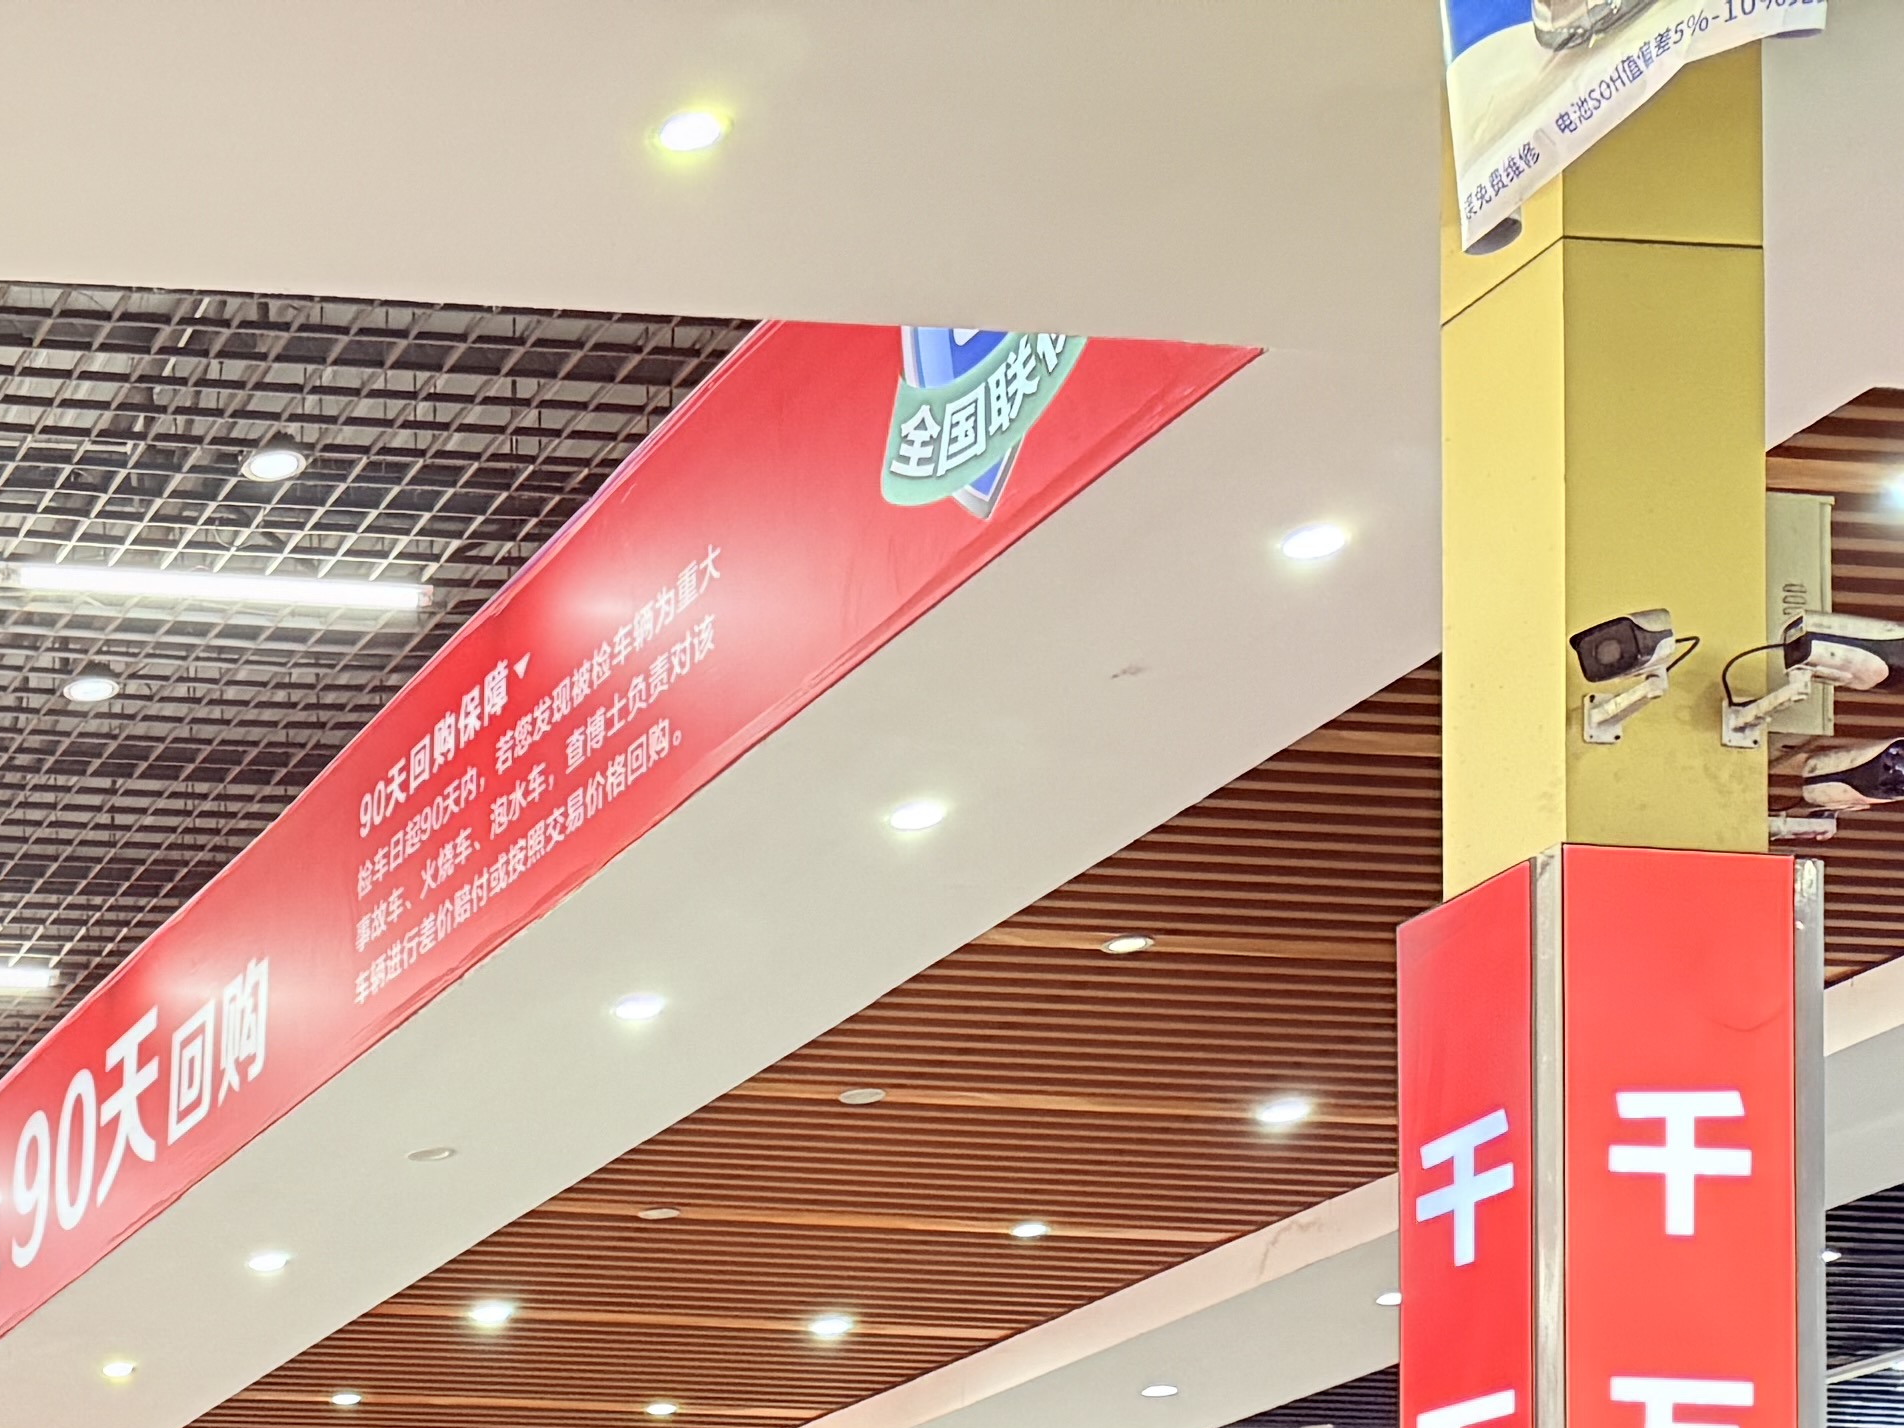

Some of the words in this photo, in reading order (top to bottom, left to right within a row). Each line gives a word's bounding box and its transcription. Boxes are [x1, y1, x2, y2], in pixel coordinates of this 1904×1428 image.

[358, 659, 511, 838] 90天回购保障
